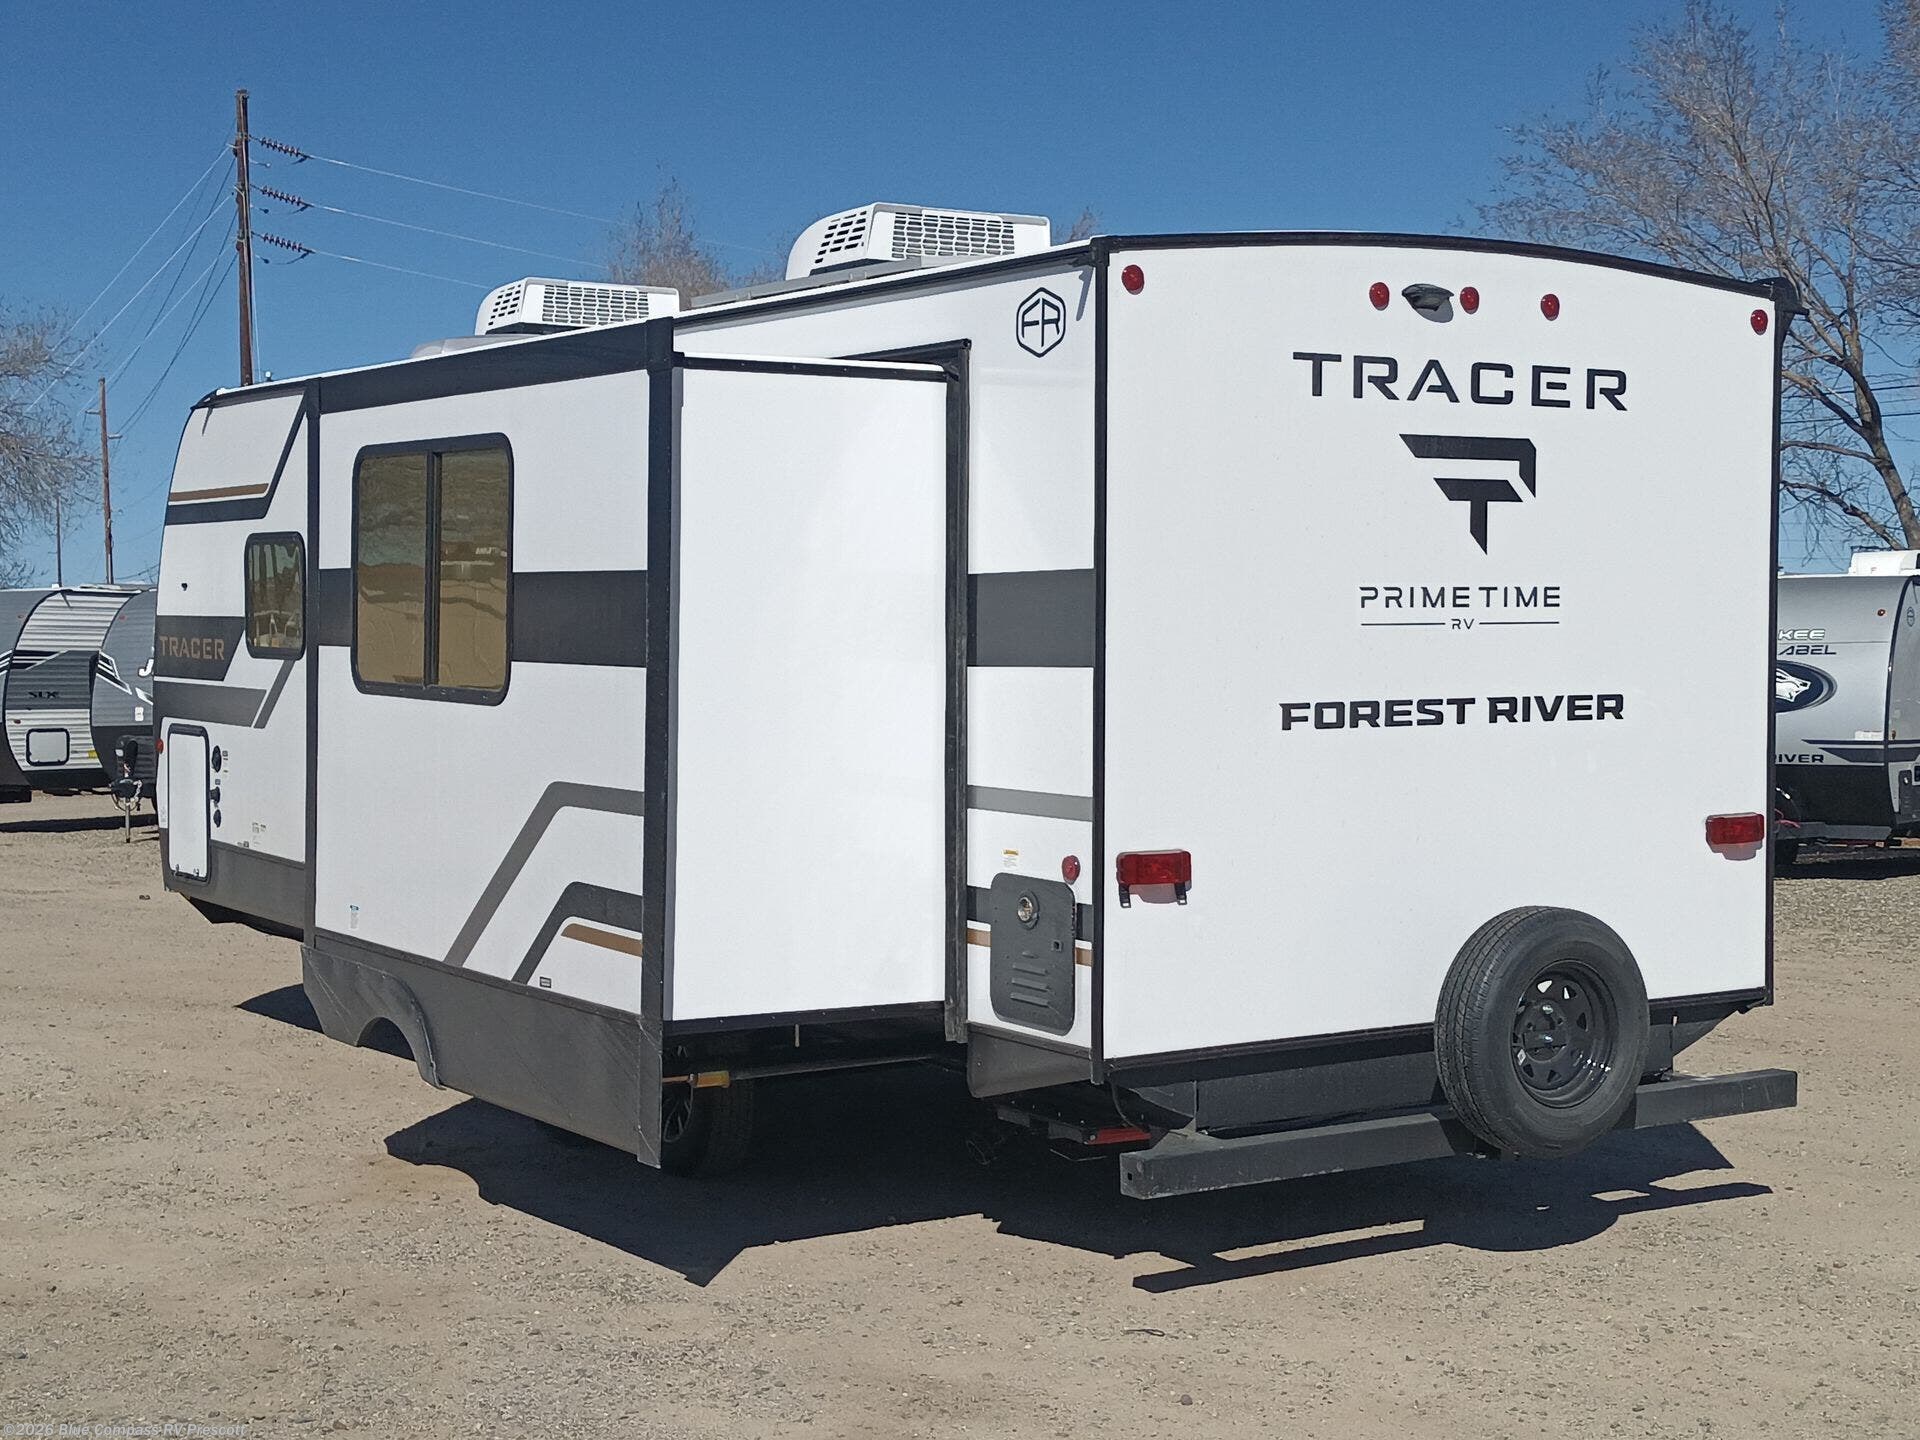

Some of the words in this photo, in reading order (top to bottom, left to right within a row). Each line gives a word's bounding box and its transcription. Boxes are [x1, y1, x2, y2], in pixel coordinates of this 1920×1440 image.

[1292, 351, 1628, 412] TRACER
[1359, 586, 1470, 608] PRIME
[1478, 586, 1560, 608] TIME
[1450, 618, 1475, 630] RV
[160, 635, 225, 660] TRACER
[1279, 697, 1476, 731] FOREST
[1486, 693, 1624, 723] RIVER
[1774, 753, 1824, 763] IVER
